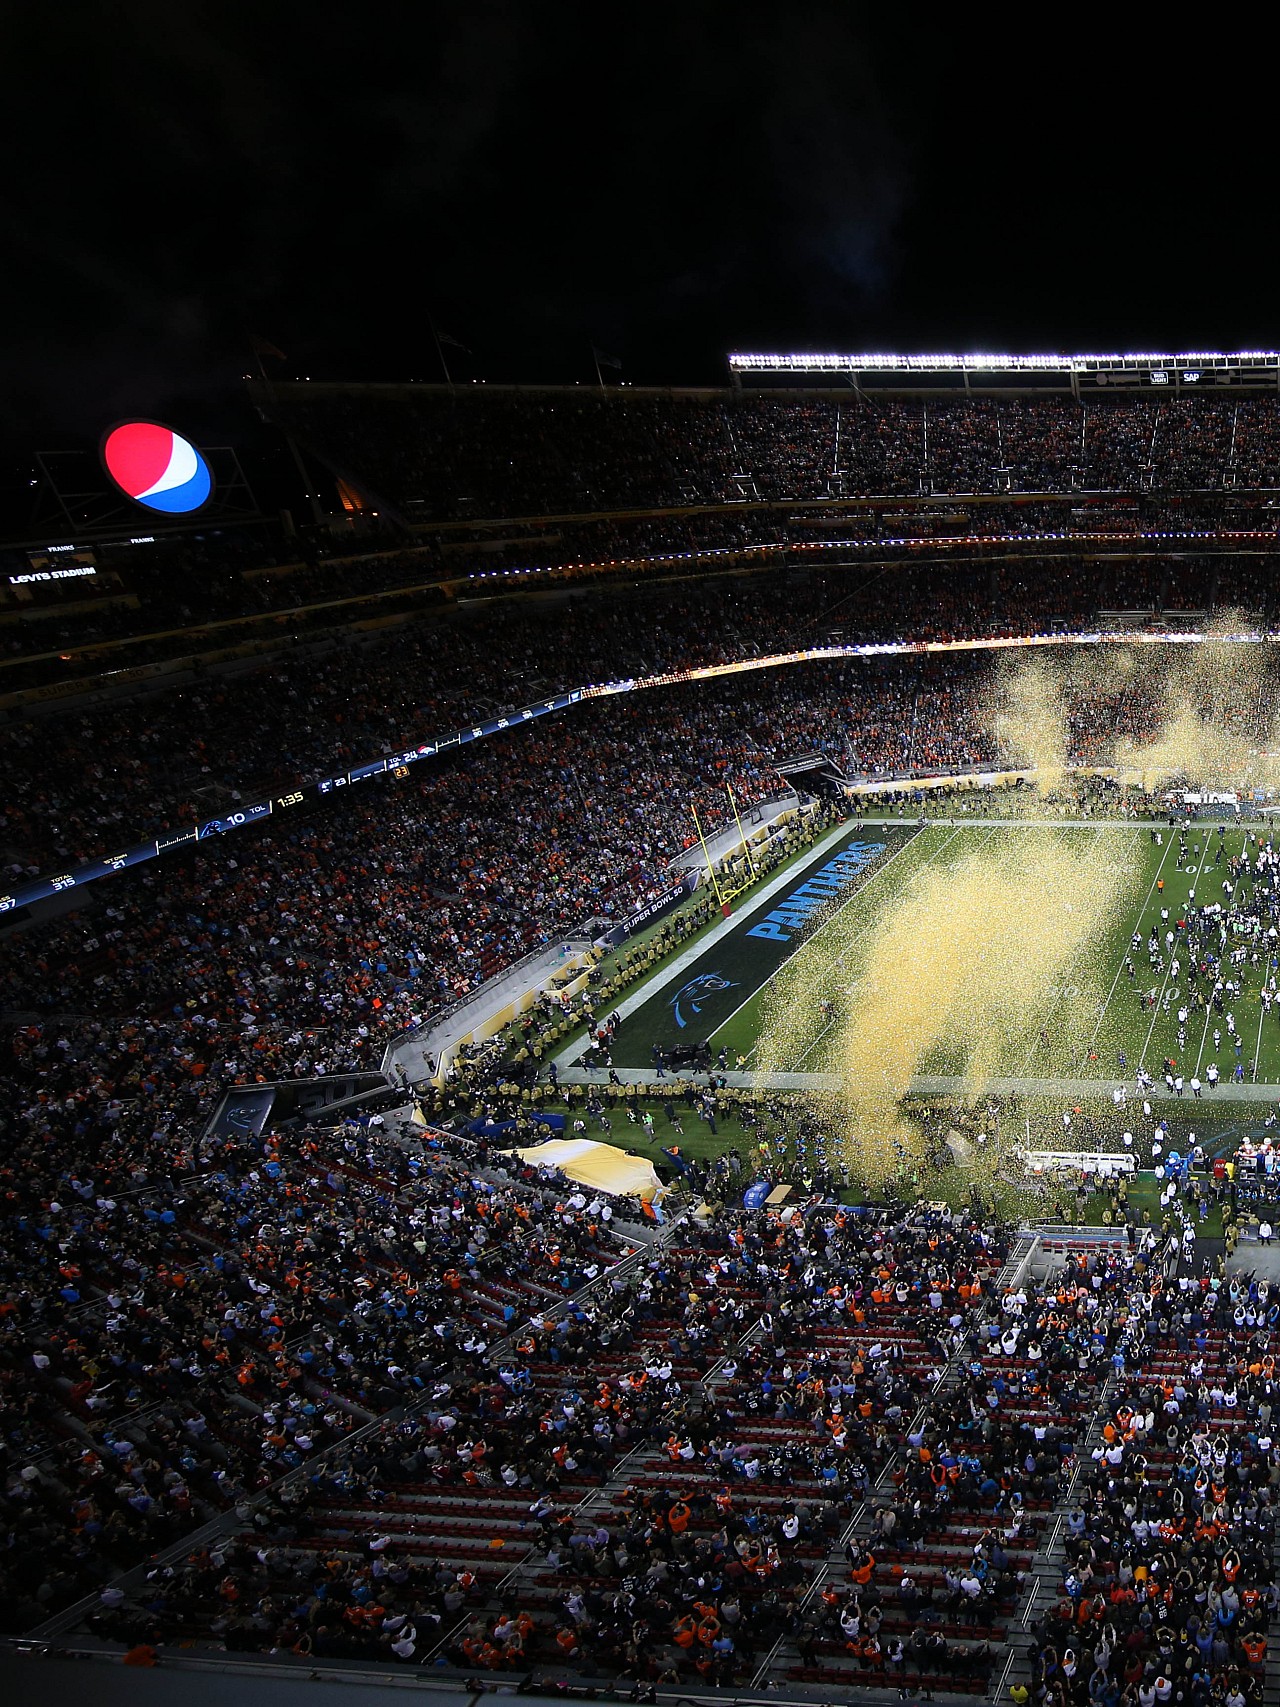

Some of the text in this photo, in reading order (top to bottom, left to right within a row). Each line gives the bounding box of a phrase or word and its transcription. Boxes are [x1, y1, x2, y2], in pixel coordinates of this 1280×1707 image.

[1184, 373, 1200, 382] SAP
[51, 566, 97, 580] STADIUM
[472, 730, 482, 738] 90
[403, 750, 418, 762] 24
[394, 766, 408, 777] 23
[334, 778, 346, 786] 23
[276, 792, 304, 808] 1:35
[226, 805, 266, 826] 10 TOL
[111, 860, 126, 870] 21
[50, 874, 72, 884] TOTAL
[52, 878, 76, 890] 315
[745, 841, 887, 942] PANTHERS
[624, 886, 683, 932] SUPER BOWL 50
